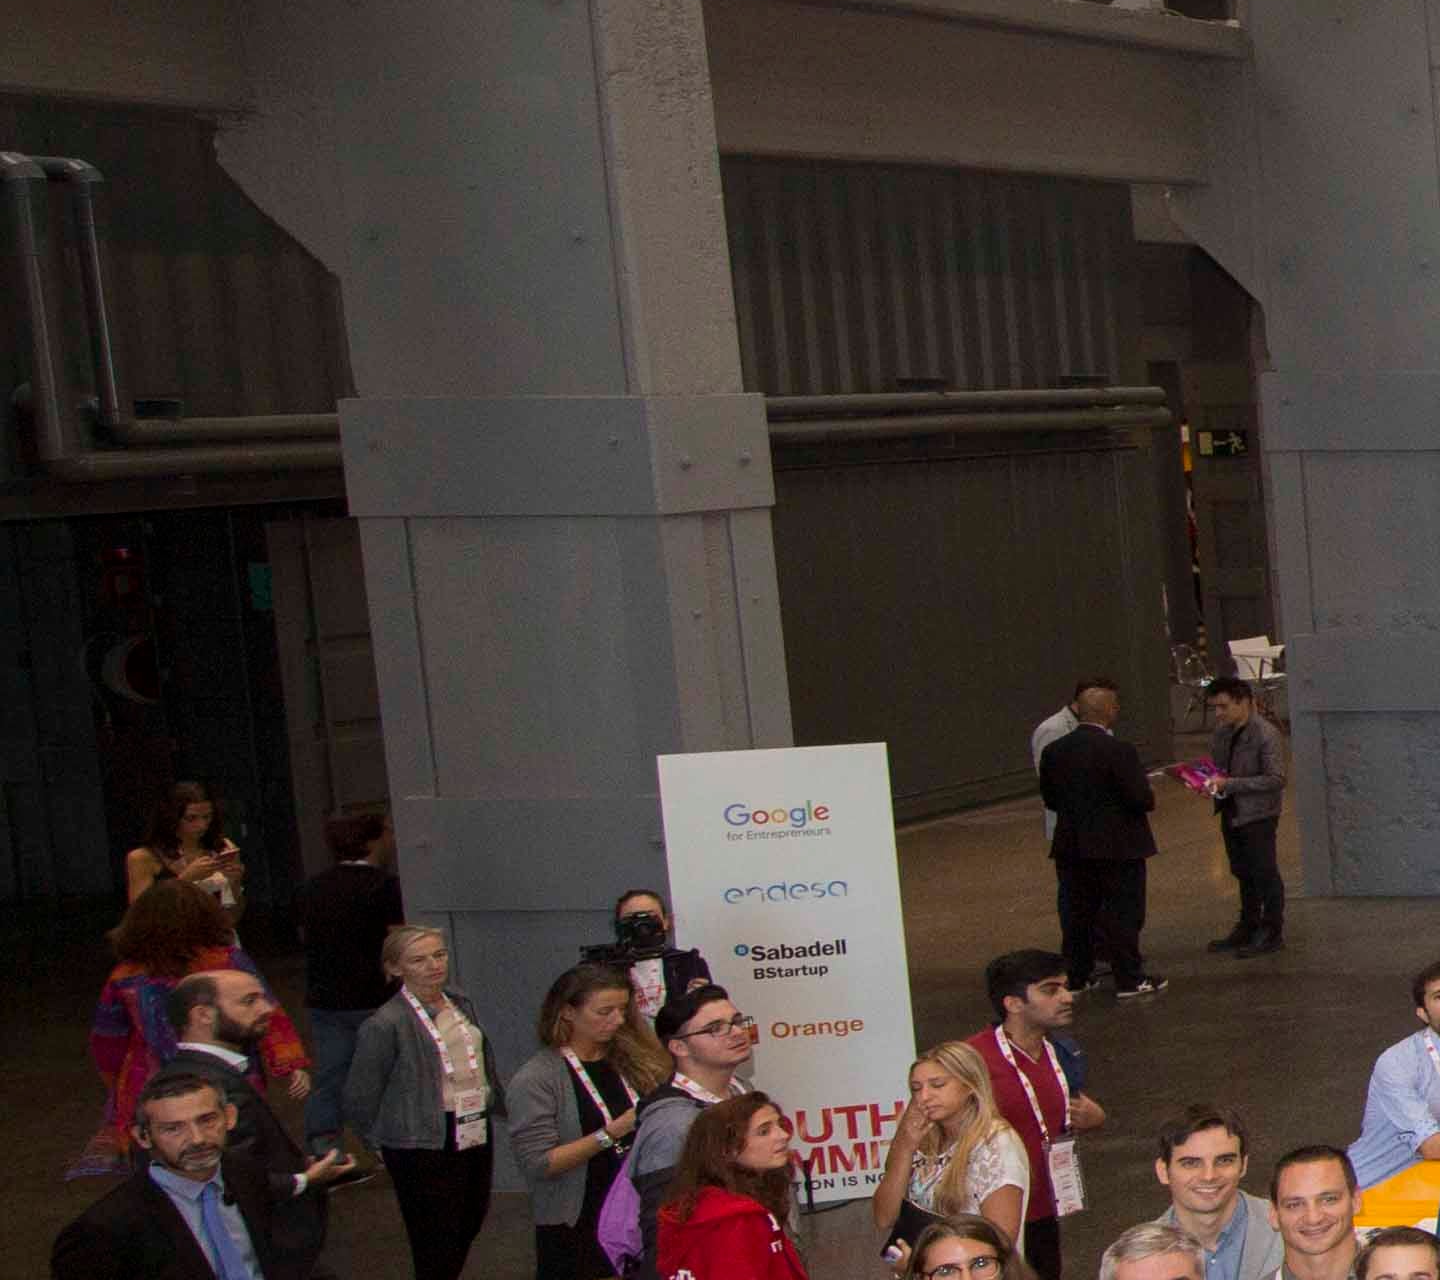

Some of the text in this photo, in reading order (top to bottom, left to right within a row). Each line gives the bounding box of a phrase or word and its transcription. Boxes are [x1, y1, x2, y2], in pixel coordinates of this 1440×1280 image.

[724, 799, 830, 829] Google
[746, 826, 832, 840] Entrepreneurs
[724, 880, 848, 904] endesa
[751, 939, 848, 962] Sabadell
[753, 963, 829, 980] BStartup
[771, 1018, 865, 1039] Orange
[842, 1176, 858, 1186] IS
